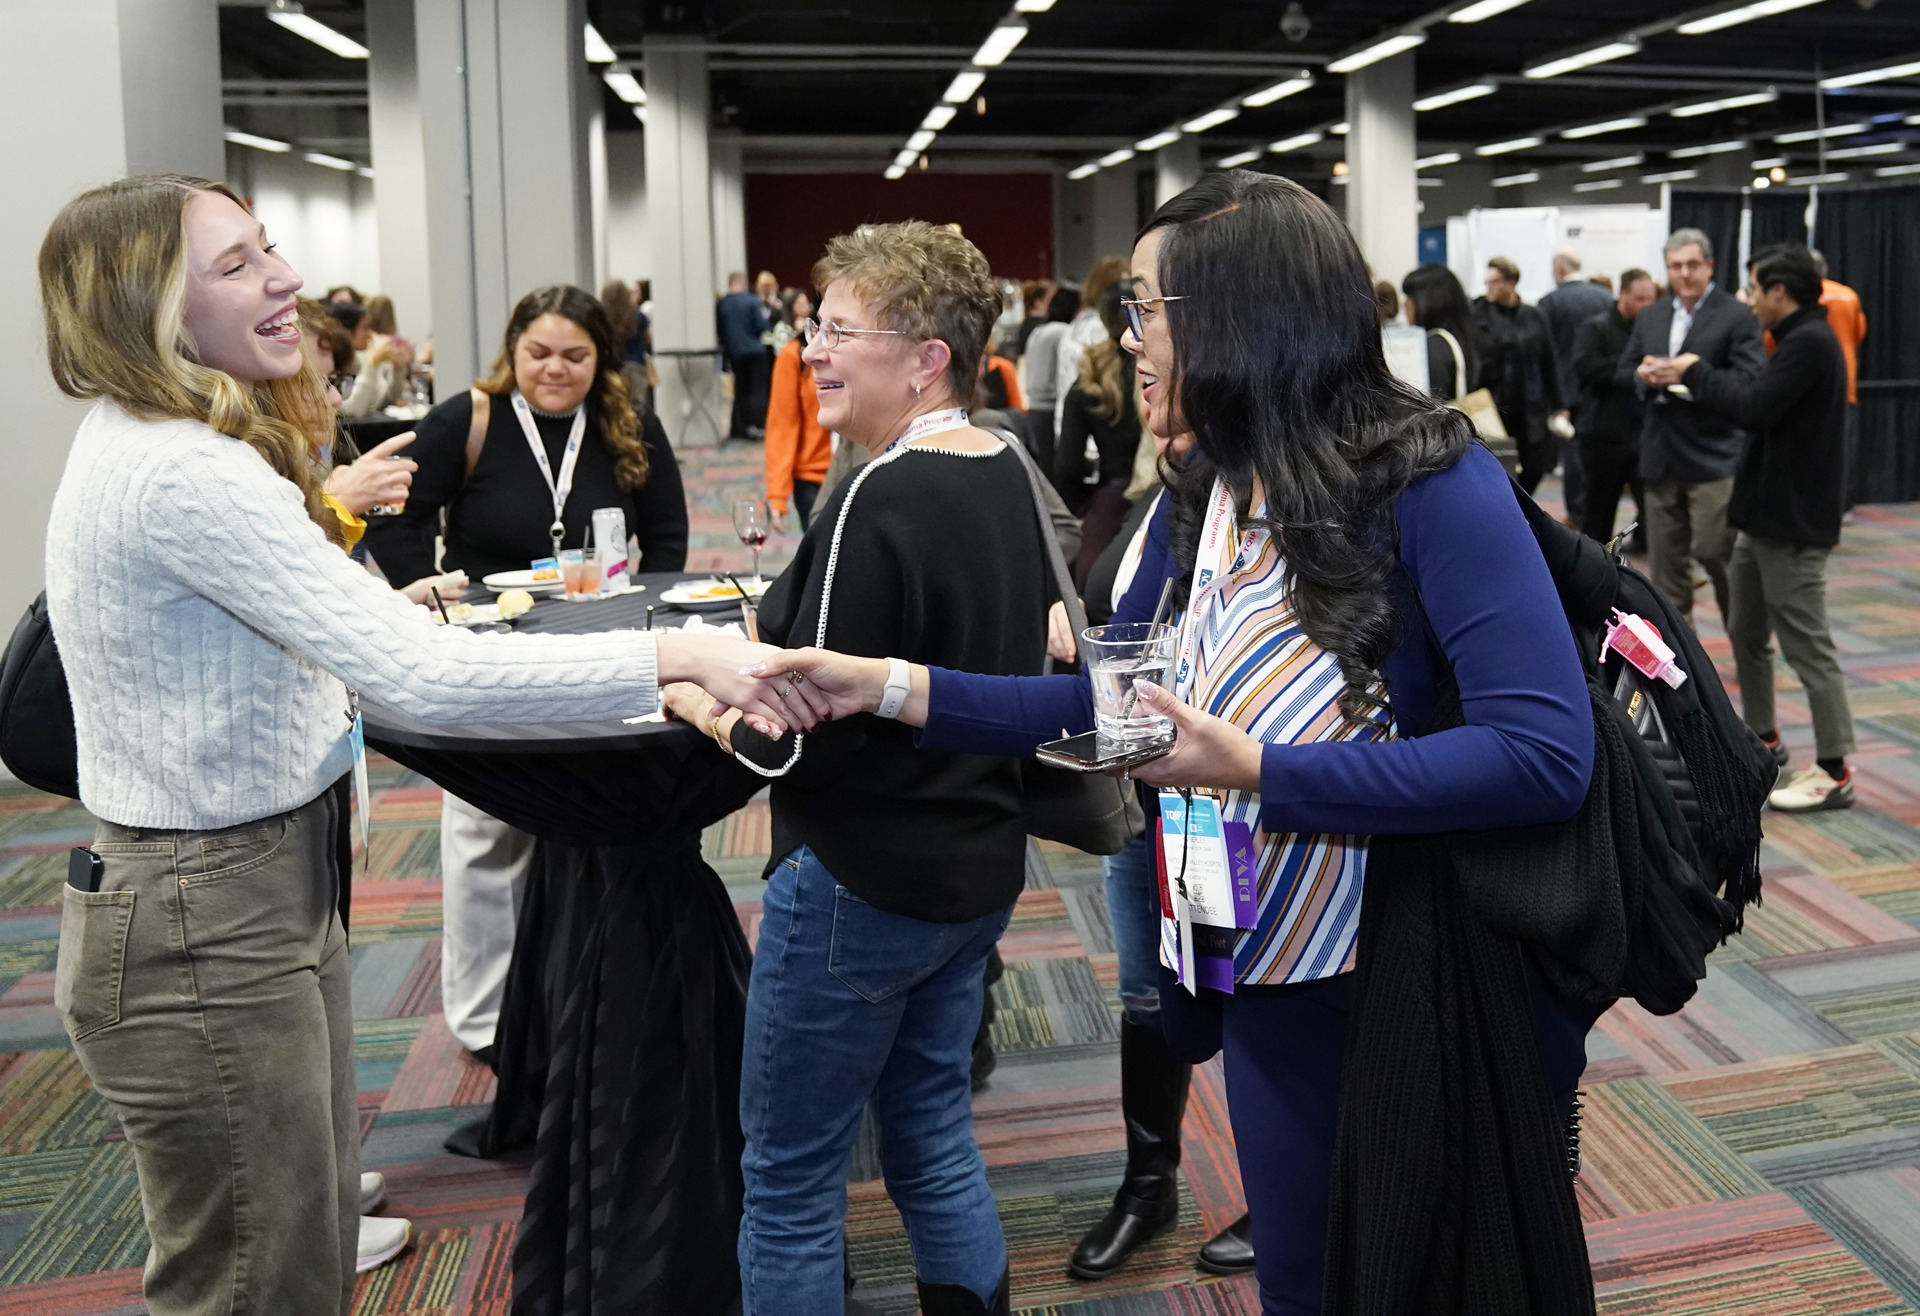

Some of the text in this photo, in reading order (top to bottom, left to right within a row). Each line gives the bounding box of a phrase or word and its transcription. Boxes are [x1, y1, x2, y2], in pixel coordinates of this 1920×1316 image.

[1208, 508, 1226, 549] Programs
[1243, 530, 1258, 553] TQIP
[1235, 847, 1250, 901] DIVA
[1189, 904, 1218, 916] TTENDEE
